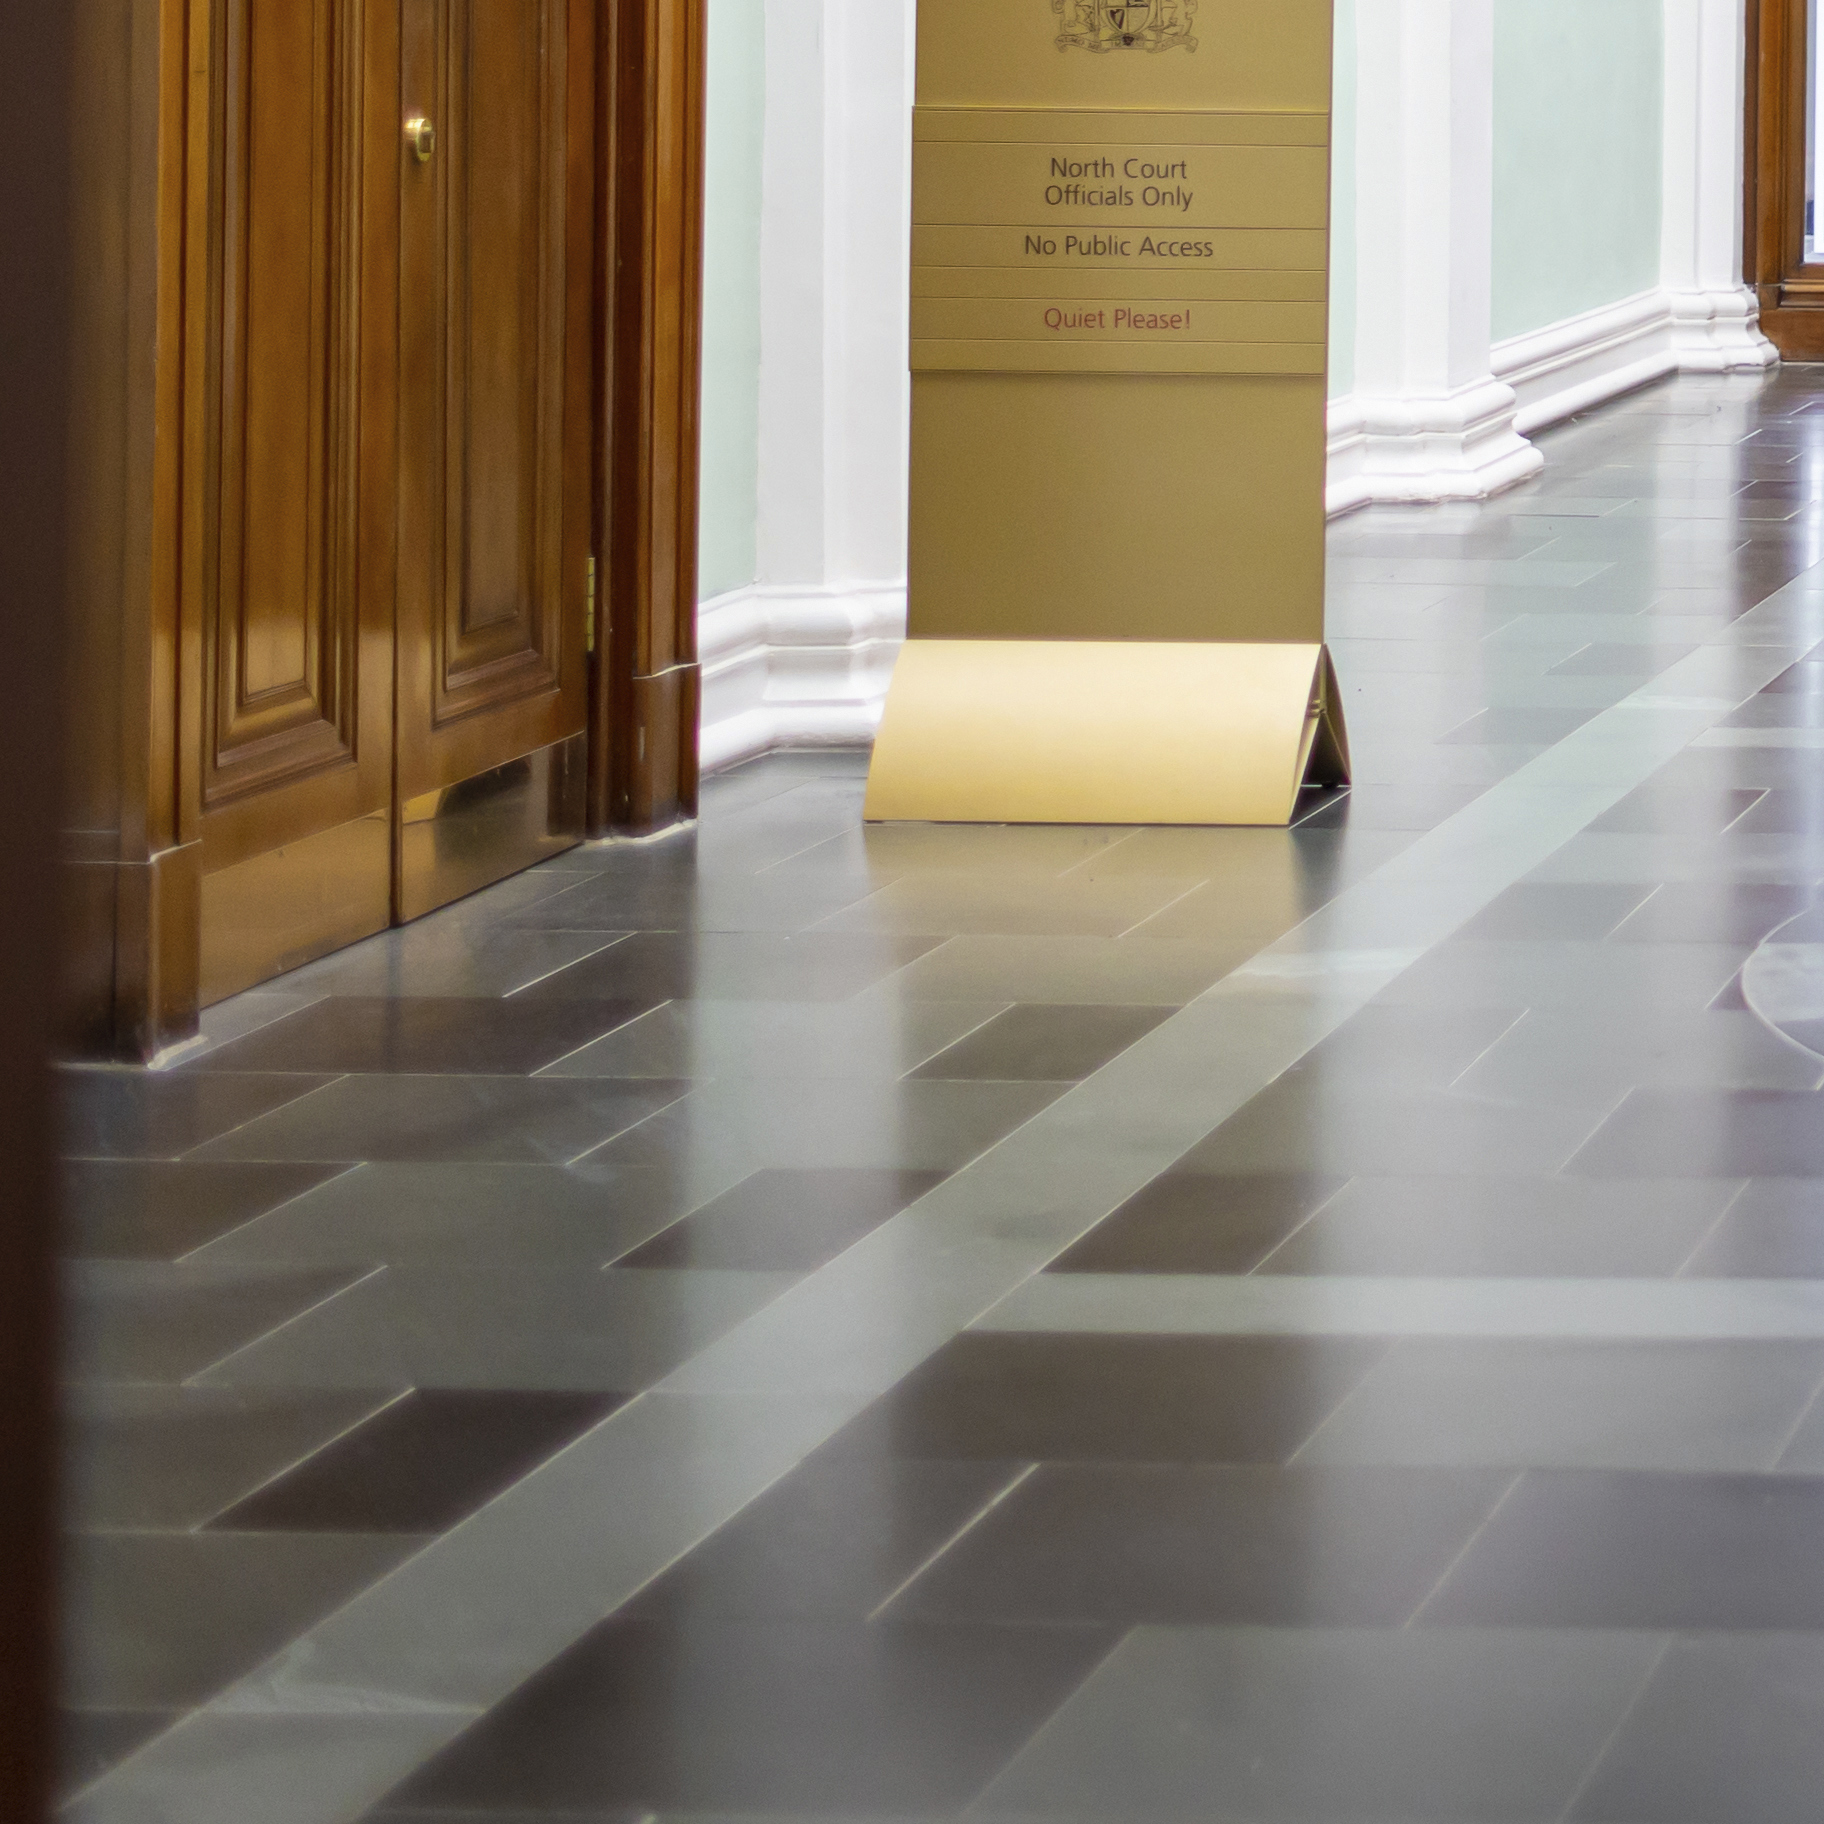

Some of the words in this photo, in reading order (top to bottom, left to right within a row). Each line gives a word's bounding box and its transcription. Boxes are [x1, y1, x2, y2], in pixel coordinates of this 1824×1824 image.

[1051, 156, 1115, 178] North
[1123, 158, 1188, 180] Court
[1044, 184, 1135, 206] Officials
[1142, 185, 1194, 212] Only
[1025, 235, 1057, 256] No
[1065, 234, 1131, 256] Public
[1138, 236, 1214, 257] Access
[1043, 307, 1105, 330] Quiet
[1114, 307, 1191, 330] Please!
